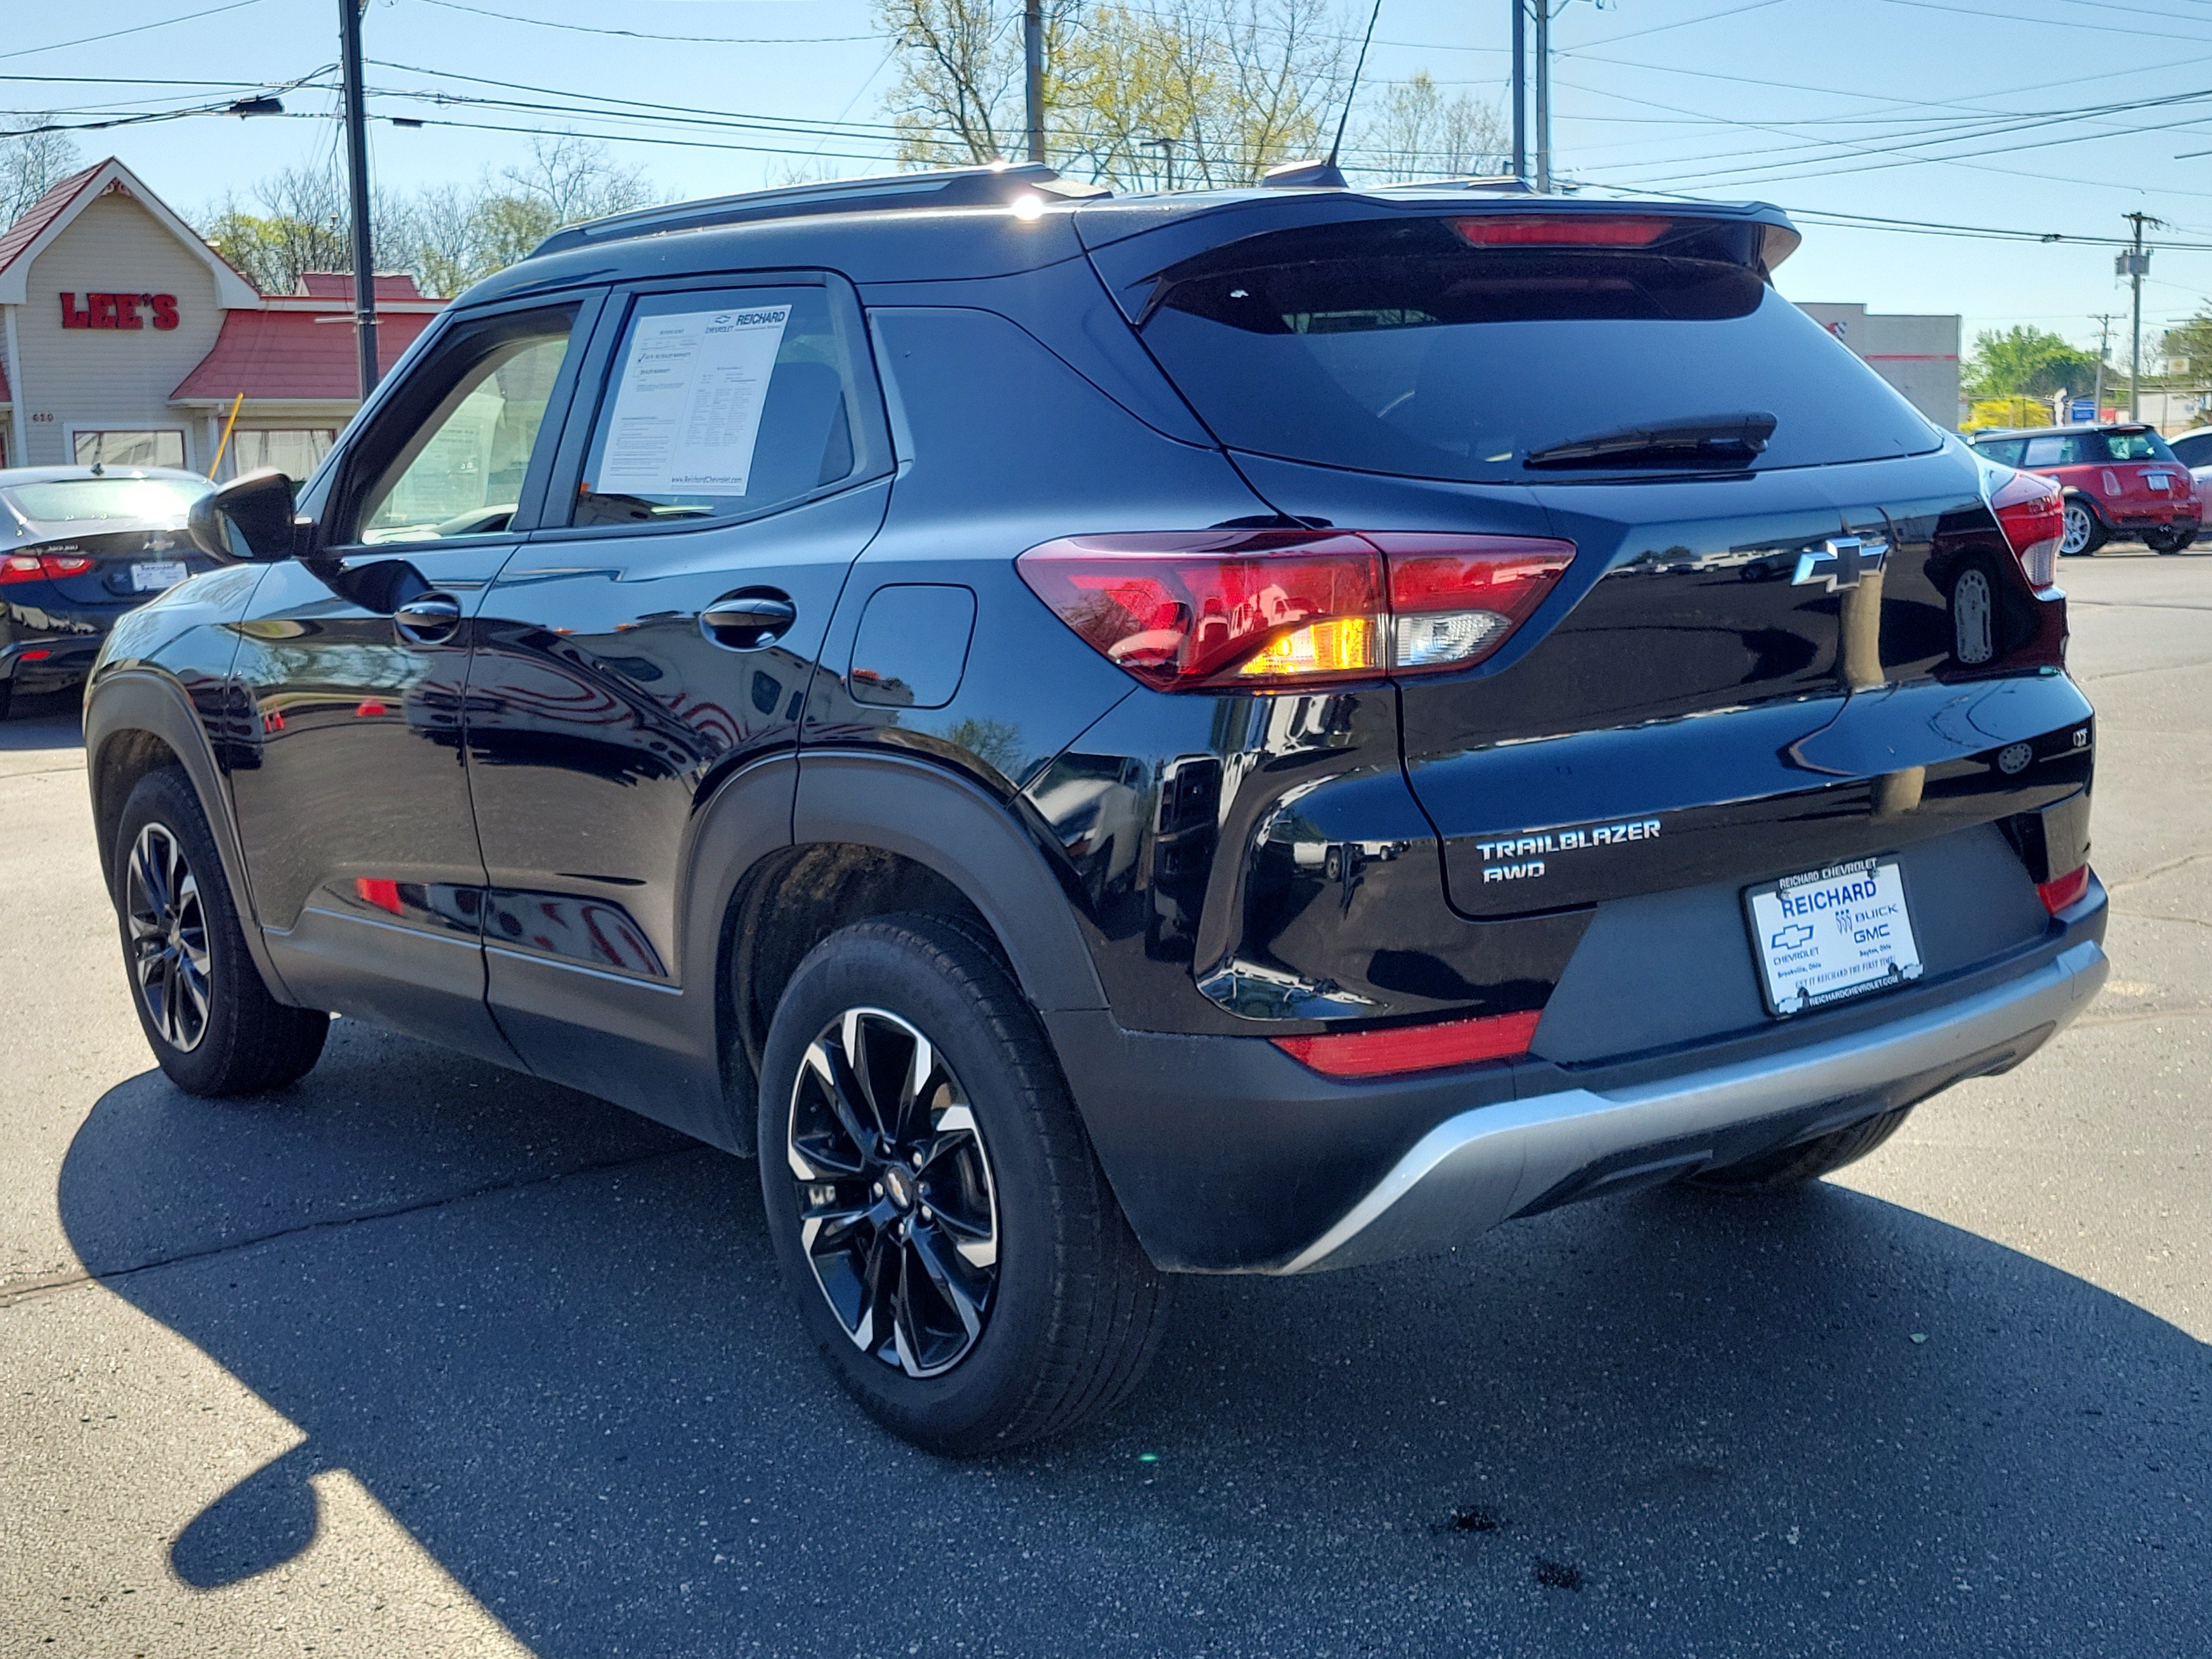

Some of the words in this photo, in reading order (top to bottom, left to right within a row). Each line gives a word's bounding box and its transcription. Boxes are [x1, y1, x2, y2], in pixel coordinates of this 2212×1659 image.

[59, 292, 180, 331] LEE'S
[736, 311, 785, 326] REICHARD
[1476, 819, 1661, 862] TRAILBLAZER
[1482, 860, 1545, 884] AWD
[1779, 871, 1819, 889] REICHARD
[1821, 857, 1877, 879] CHEVROLET
[1782, 879, 1877, 919] REICHARD
[1855, 904, 1899, 923] BUICK
[1854, 923, 1891, 944] GMC
[1773, 947, 1819, 966] CHEVROLET
[1817, 968, 1848, 984] REICHARD
[1849, 965, 1860, 976] THE
[1863, 960, 1878, 972] FIRST
[1809, 974, 1899, 1007] REICHARDCHEVROLET.COM
